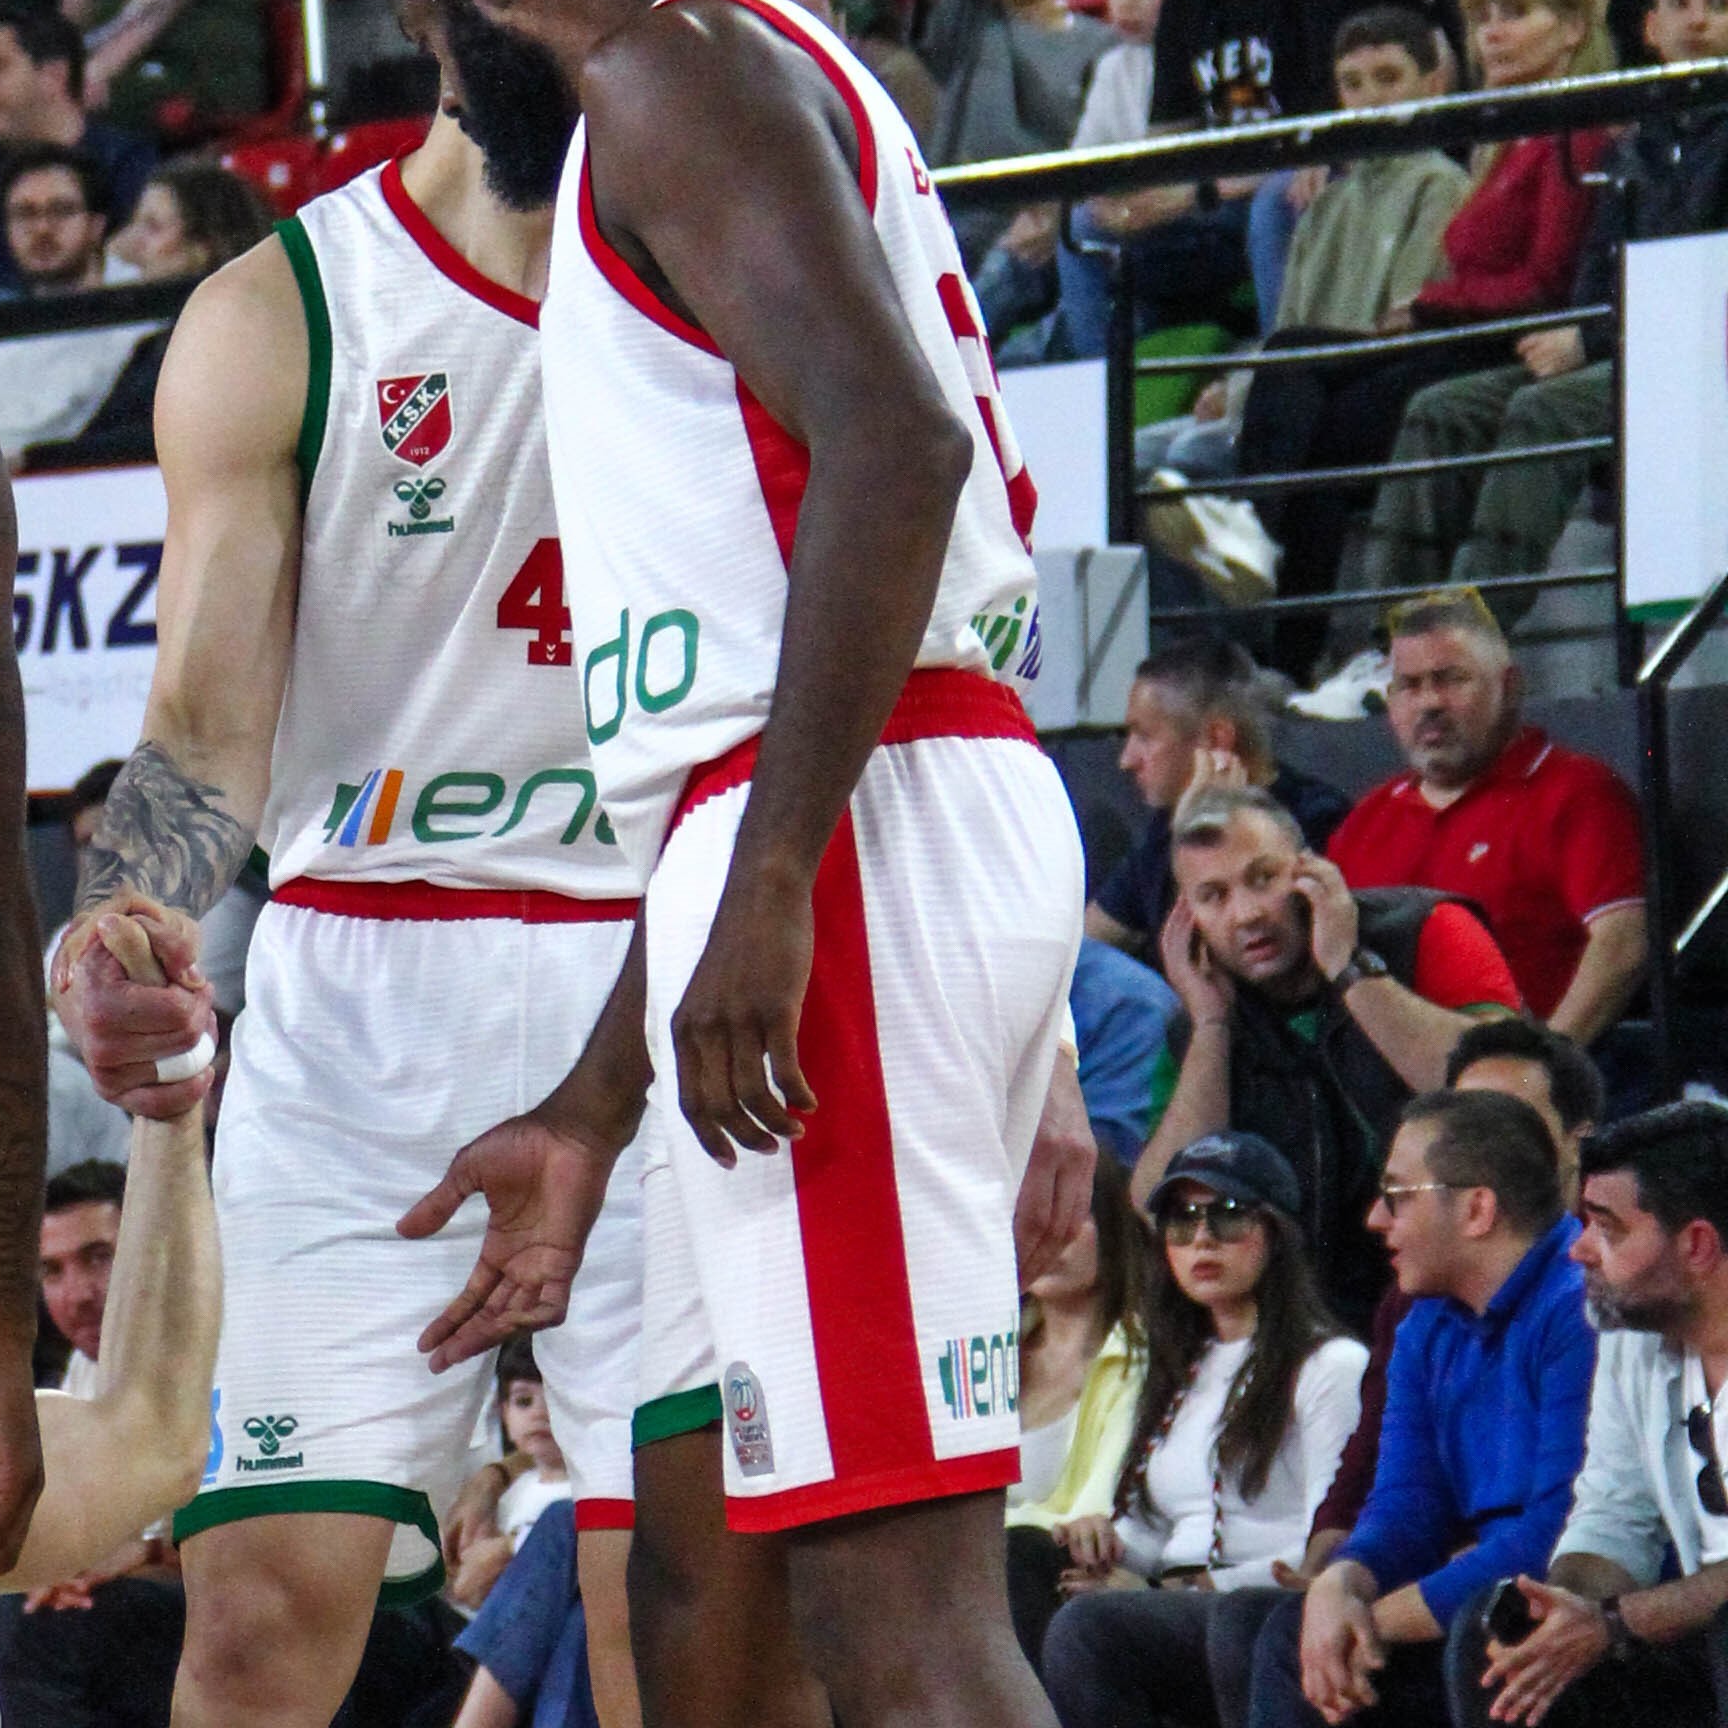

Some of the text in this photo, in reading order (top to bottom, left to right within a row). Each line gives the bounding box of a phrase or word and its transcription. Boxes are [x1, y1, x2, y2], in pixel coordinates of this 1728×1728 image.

[388, 386, 441, 441] K.S.K.
[387, 515, 455, 537] hummel
[235, 1451, 304, 1472] hummel
